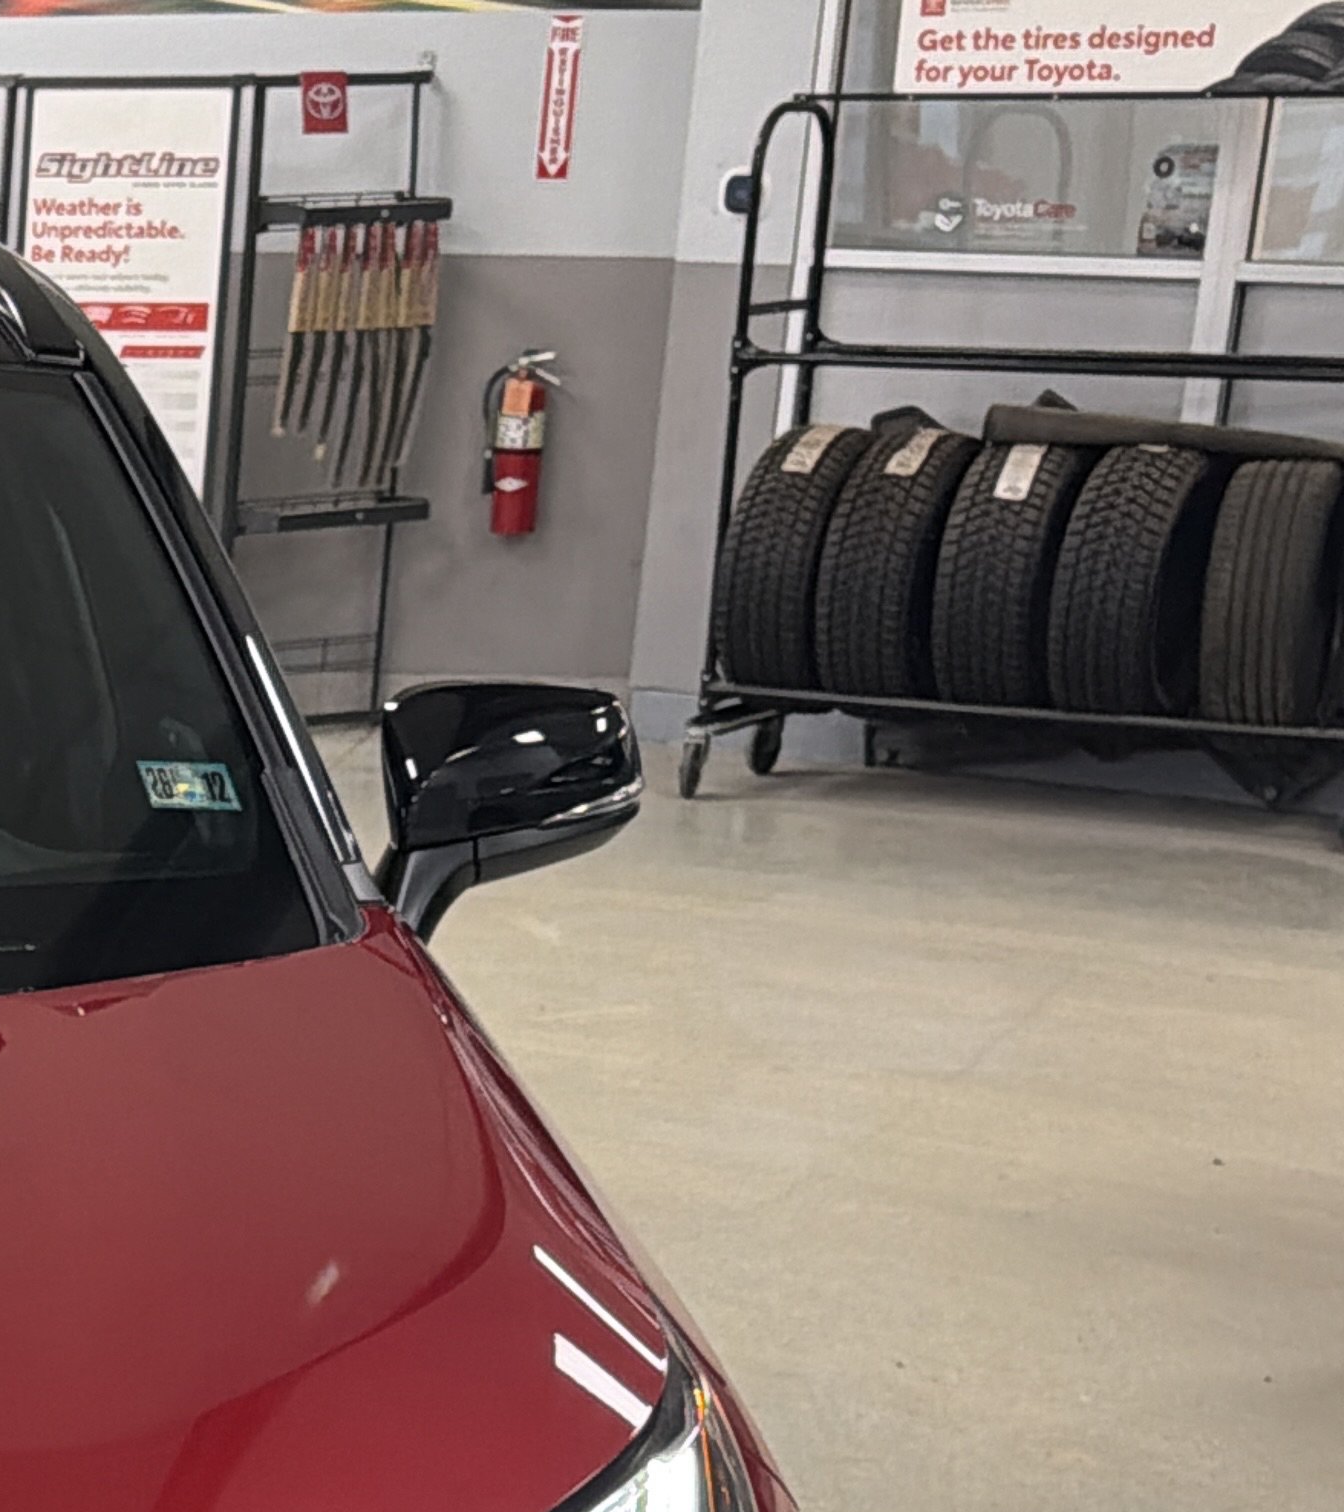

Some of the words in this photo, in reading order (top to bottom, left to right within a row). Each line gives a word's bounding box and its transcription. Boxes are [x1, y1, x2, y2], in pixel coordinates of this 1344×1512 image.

[917, 28, 966, 51] Get
[972, 27, 1017, 51] the
[1023, 25, 1082, 50] tires
[1088, 22, 1217, 56] designed
[915, 58, 954, 83] for
[957, 62, 1018, 88] your
[1024, 58, 1121, 87] Toyota.
[34, 152, 220, 184] SightLine
[33, 198, 122, 217] Weather
[125, 197, 143, 217] is
[31, 221, 185, 242] Unpredictable.
[31, 244, 56, 263] Be
[60, 244, 131, 269] Ready!
[200, 770, 233, 804] 12
